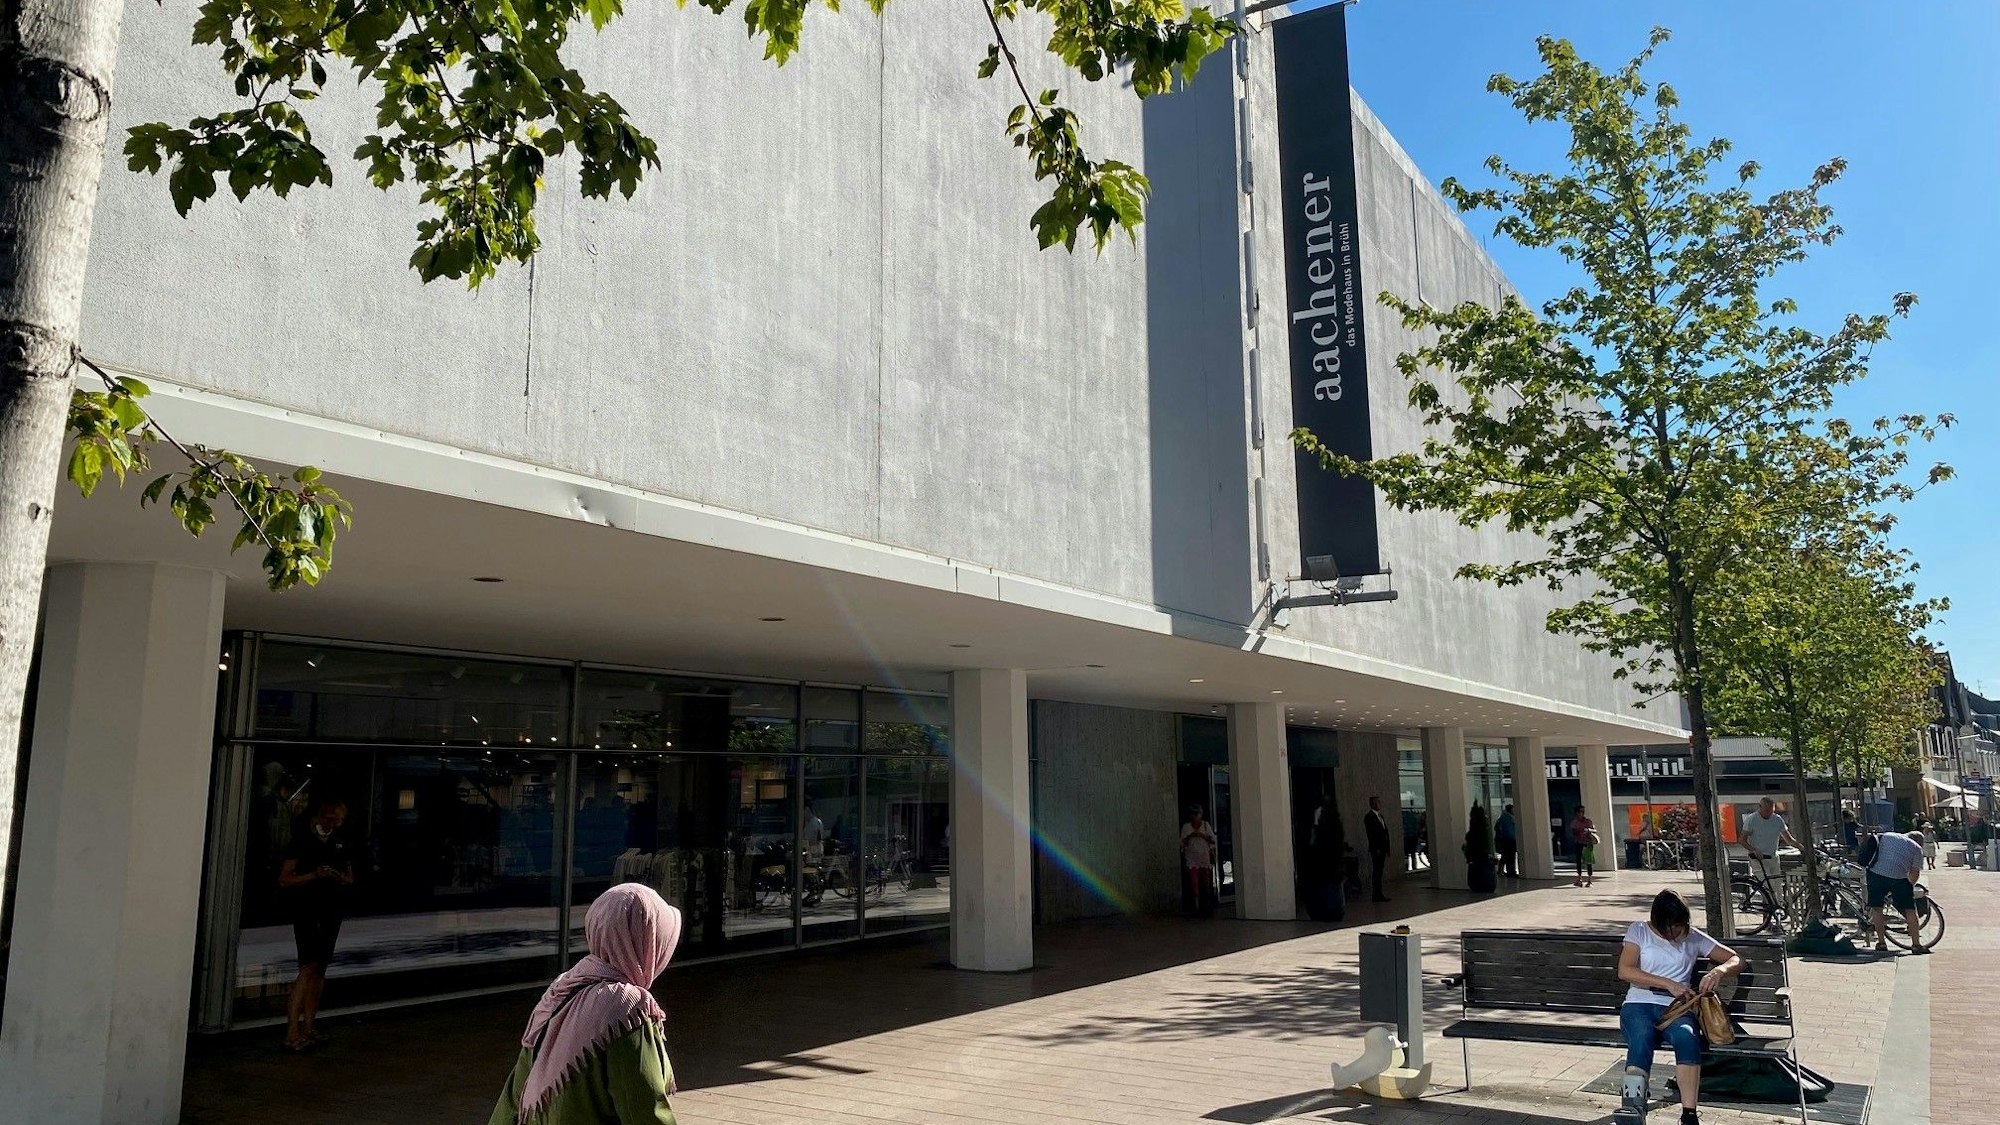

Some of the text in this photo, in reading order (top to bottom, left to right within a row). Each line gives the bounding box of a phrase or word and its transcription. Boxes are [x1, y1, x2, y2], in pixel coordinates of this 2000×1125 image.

[1293, 171, 1342, 401] aachener
[1339, 223, 1355, 346] das Modehaus in Brühl
